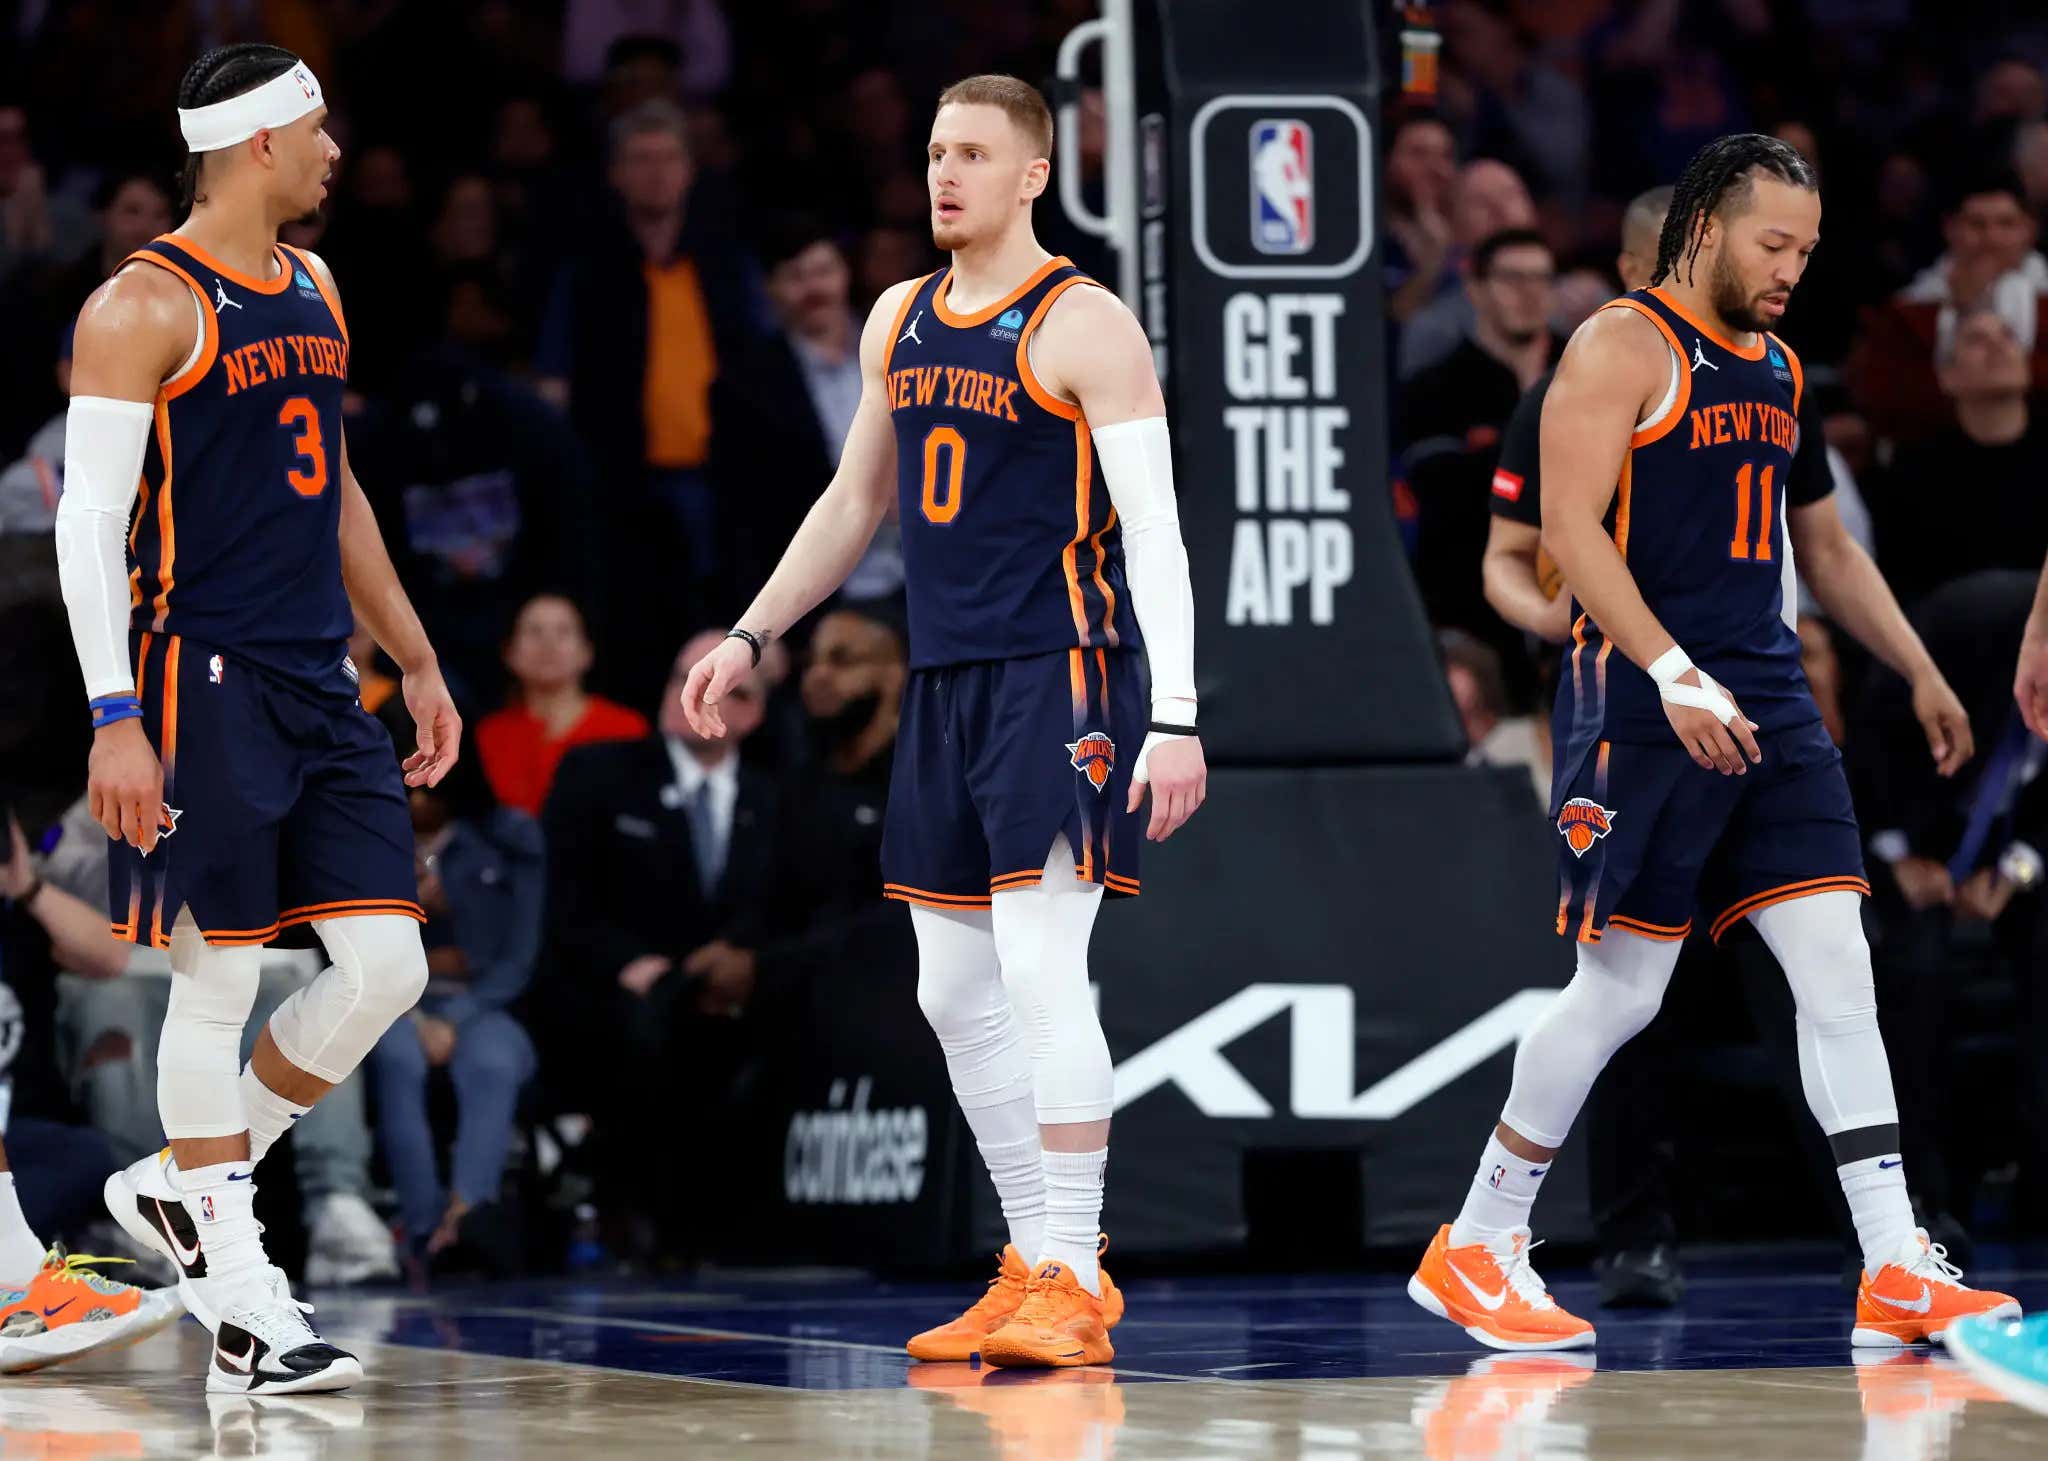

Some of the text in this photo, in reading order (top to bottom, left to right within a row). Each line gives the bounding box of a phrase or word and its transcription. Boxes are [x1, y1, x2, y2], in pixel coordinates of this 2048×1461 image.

[222, 335, 348, 397] NEW YORK
[887, 366, 1019, 423] NEW YORK
[1223, 292, 1345, 400] GET
[278, 396, 328, 497] 3
[921, 425, 967, 524] 0
[1223, 406, 1351, 513] THE
[1690, 402, 1753, 450] NEW
[1730, 462, 1775, 561] 11
[1225, 518, 1354, 626] APP
[1560, 804, 1610, 831] KNICKS
